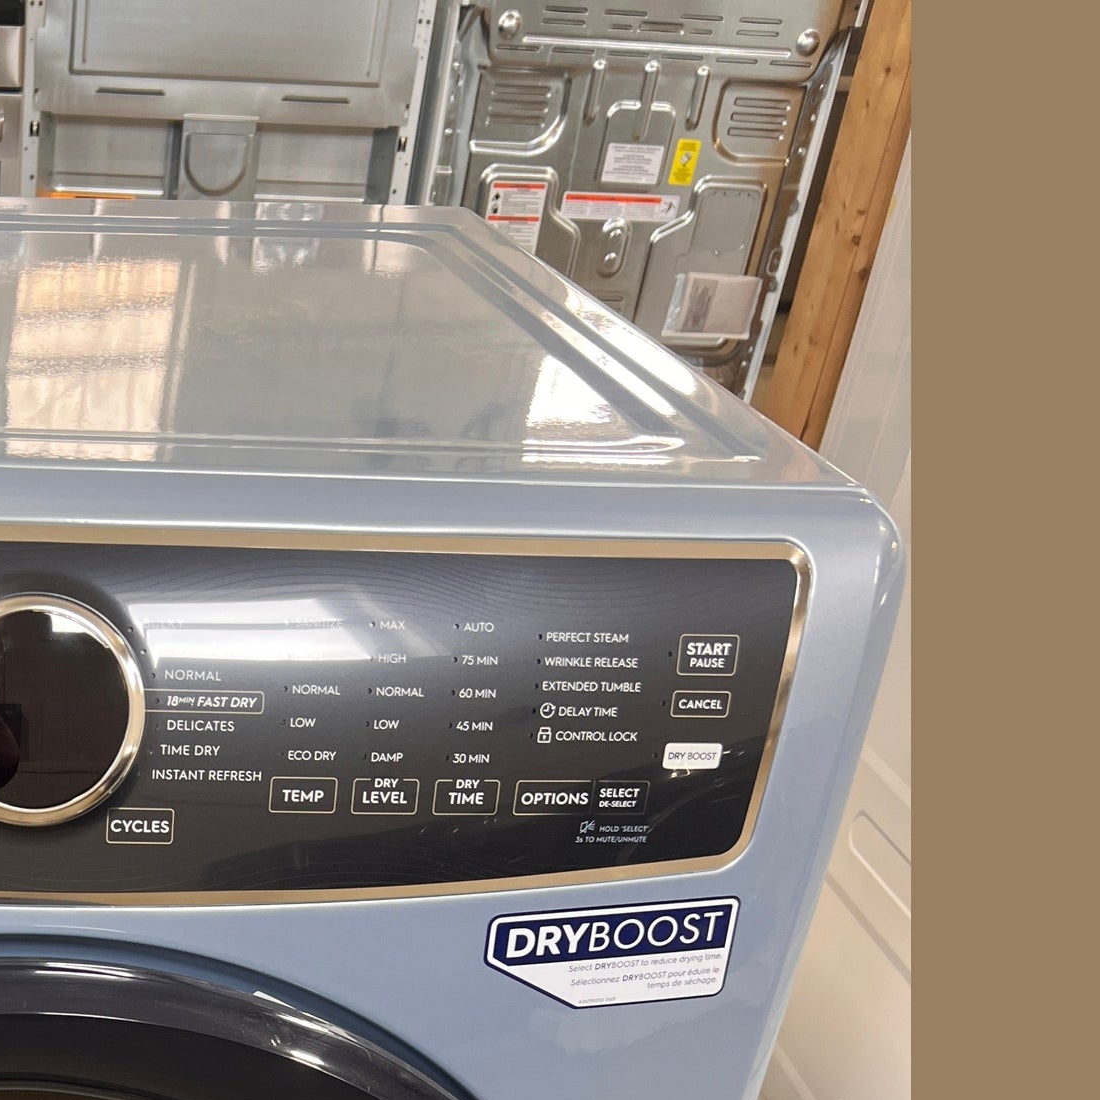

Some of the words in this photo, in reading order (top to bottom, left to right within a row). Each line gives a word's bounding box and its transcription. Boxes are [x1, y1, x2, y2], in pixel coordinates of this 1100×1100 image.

[380, 620, 406, 630] MAX
[463, 622, 495, 633] AUTO
[546, 632, 591, 643] PERFECT
[593, 633, 629, 643] STEAM
[686, 642, 732, 656] START
[378, 653, 407, 664] HIGH
[461, 655, 474, 665] 75
[476, 655, 498, 666] MIN
[544, 657, 592, 668] WRINKLE
[594, 657, 638, 669] RELEASE
[689, 658, 725, 669] PAUSE
[164, 669, 222, 682] NORMAL
[292, 685, 341, 695] NORMAL
[376, 686, 425, 697] NORMAL
[542, 681, 598, 692] EXTENDED
[600, 681, 642, 693] TUMBLE
[458, 688, 472, 698] 60
[474, 688, 497, 699] MIN
[197, 696, 229, 708] FAST
[230, 697, 258, 708] DRY
[678, 698, 723, 710] CANCEL
[558, 706, 594, 717] DELAY
[594, 706, 618, 717] TIME
[166, 720, 235, 732] DELICATES
[290, 717, 316, 728] LOW
[373, 719, 400, 730] LOW
[456, 721, 469, 731] 45
[471, 721, 493, 732] MIN
[555, 730, 607, 741] CONTROL
[608, 731, 638, 742] LOCK
[160, 744, 190, 756] TIME
[194, 745, 220, 756] DRY
[287, 750, 312, 761] ECO
[314, 751, 337, 761] DRY
[371, 752, 403, 763] DAMP
[452, 753, 466, 764] 30
[468, 753, 490, 764] MIN
[667, 751, 686, 761] DRY
[687, 751, 717, 761] BOOST
[152, 769, 205, 781] INSTANT
[208, 770, 262, 782] REFRESH
[374, 778, 399, 788] DRY
[456, 778, 480, 789] DRY
[282, 789, 324, 802] TEMP
[362, 791, 407, 804] LEVEL
[448, 792, 485, 805] TIME
[521, 792, 589, 806] OPTIONS
[599, 788, 640, 799] SELECT
[598, 800, 637, 808] DE-SELECT
[110, 819, 170, 833] CYCLES
[599, 825, 620, 833] HOLD
[596, 836, 648, 844] MUTE/UNMUTE
[506, 911, 724, 958] DRYBOOST
[568, 965, 593, 973] Select
[594, 960, 641, 971] DRYBOOST
[650, 957, 677, 965] reduce
[679, 955, 703, 964] drying
[571, 976, 619, 987] Sélectionnez
[622, 971, 667, 982] DRYBOOST
[667, 970, 686, 979] pour
[647, 980, 670, 989] temps
